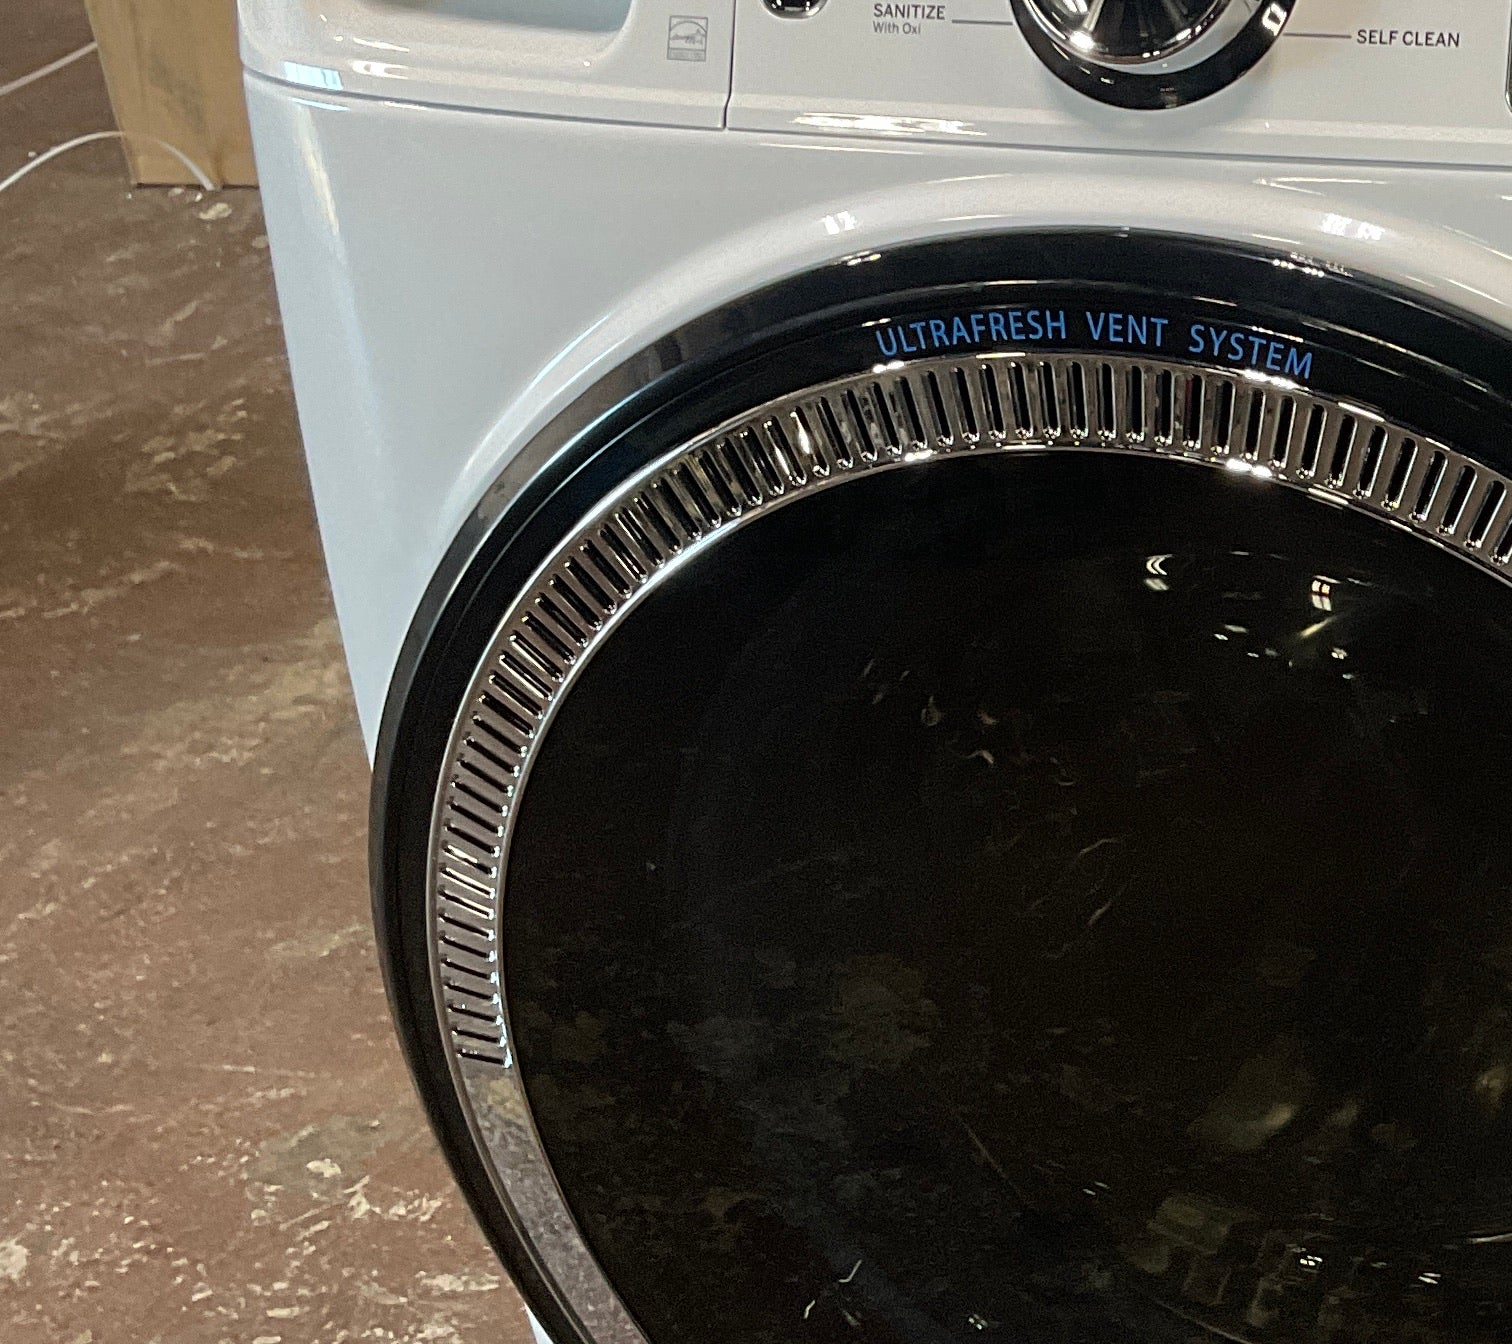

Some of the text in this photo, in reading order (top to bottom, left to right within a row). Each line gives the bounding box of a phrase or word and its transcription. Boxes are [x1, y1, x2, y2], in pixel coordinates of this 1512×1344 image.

[873, 2, 947, 21] SANITIZE
[872, 20, 922, 36] With Oxi
[1356, 28, 1461, 48] SELF CLEAN
[875, 309, 1313, 380] ULTRAFRESH VENT SYSTEM
